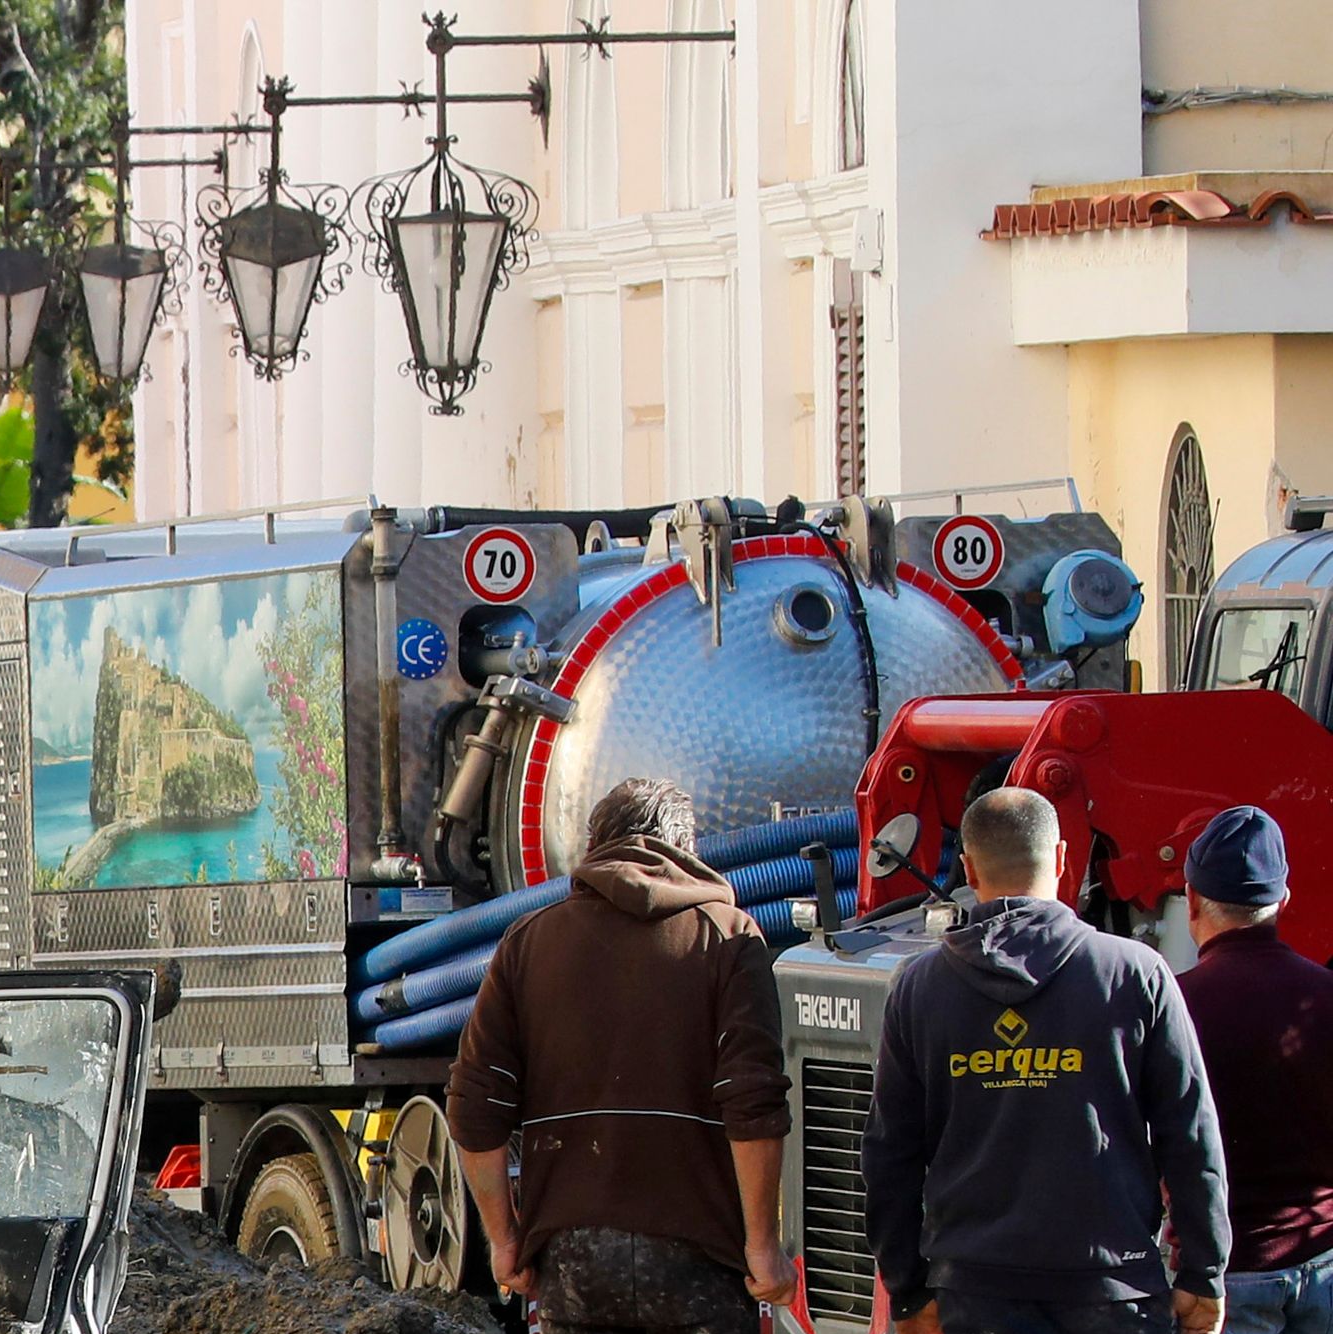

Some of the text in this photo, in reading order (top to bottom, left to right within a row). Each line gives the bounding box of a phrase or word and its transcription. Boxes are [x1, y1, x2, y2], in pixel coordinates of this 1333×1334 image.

[484, 551, 516, 578] 70
[953, 536, 986, 565] 80
[402, 635, 434, 664] CE
[949, 1048, 1083, 1078] cerqua
